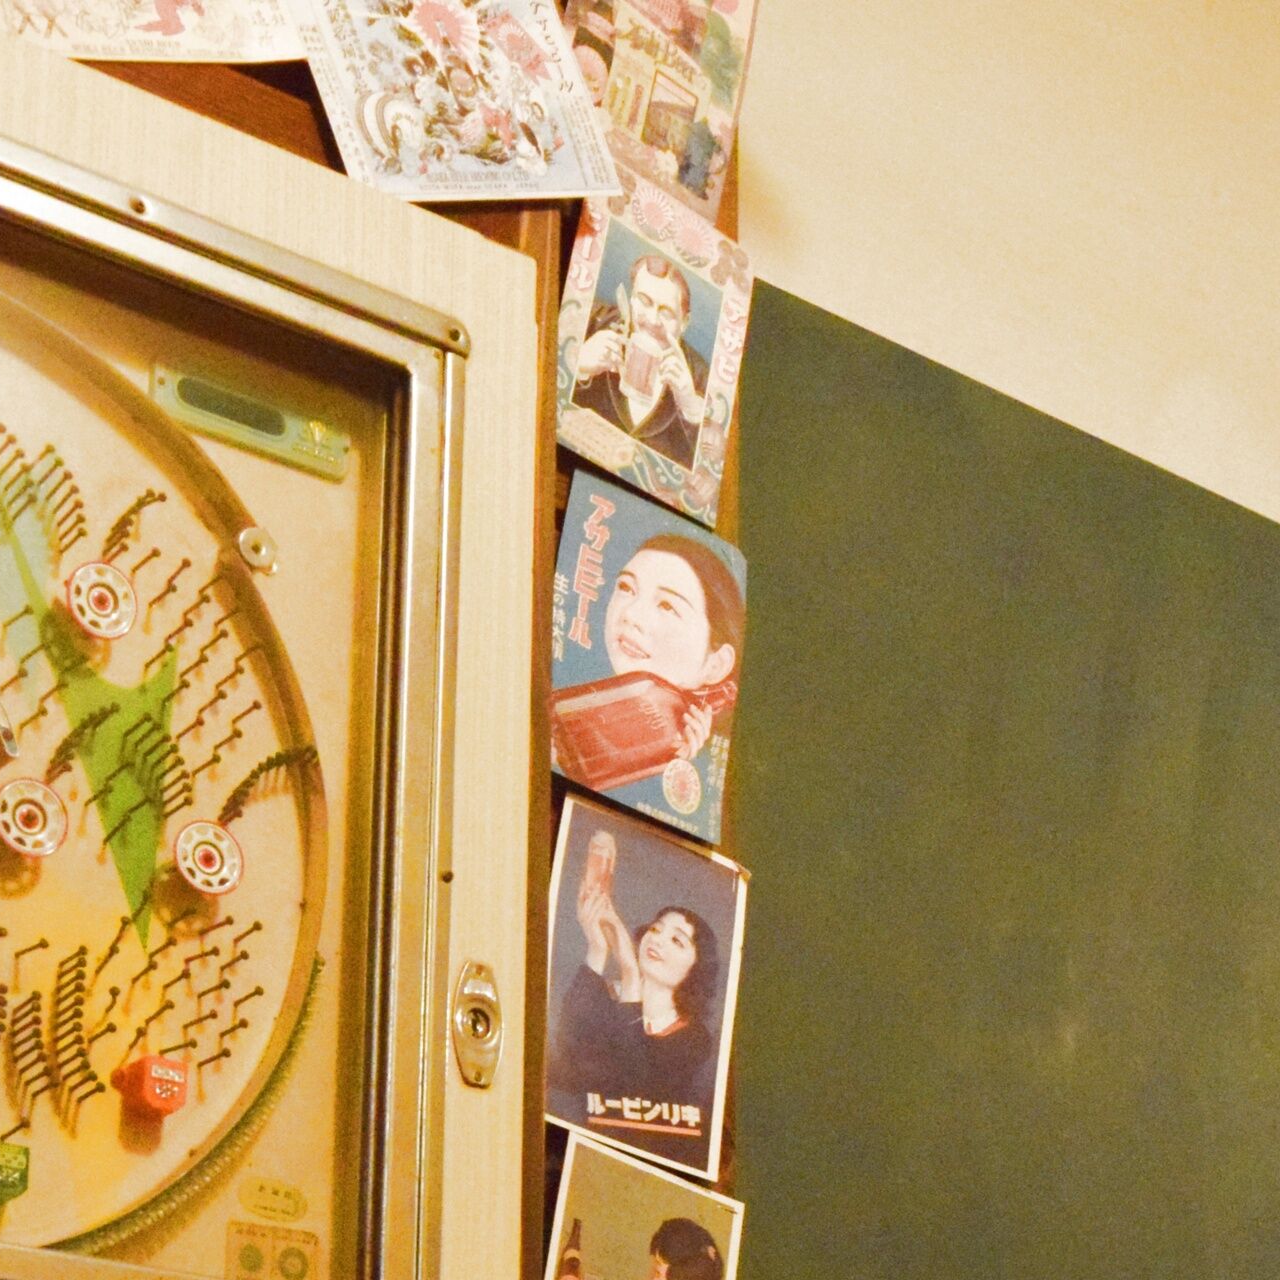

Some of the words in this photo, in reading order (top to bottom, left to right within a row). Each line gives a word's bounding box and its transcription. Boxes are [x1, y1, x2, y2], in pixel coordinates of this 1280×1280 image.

[568, 494, 616, 650] アサヒビール
